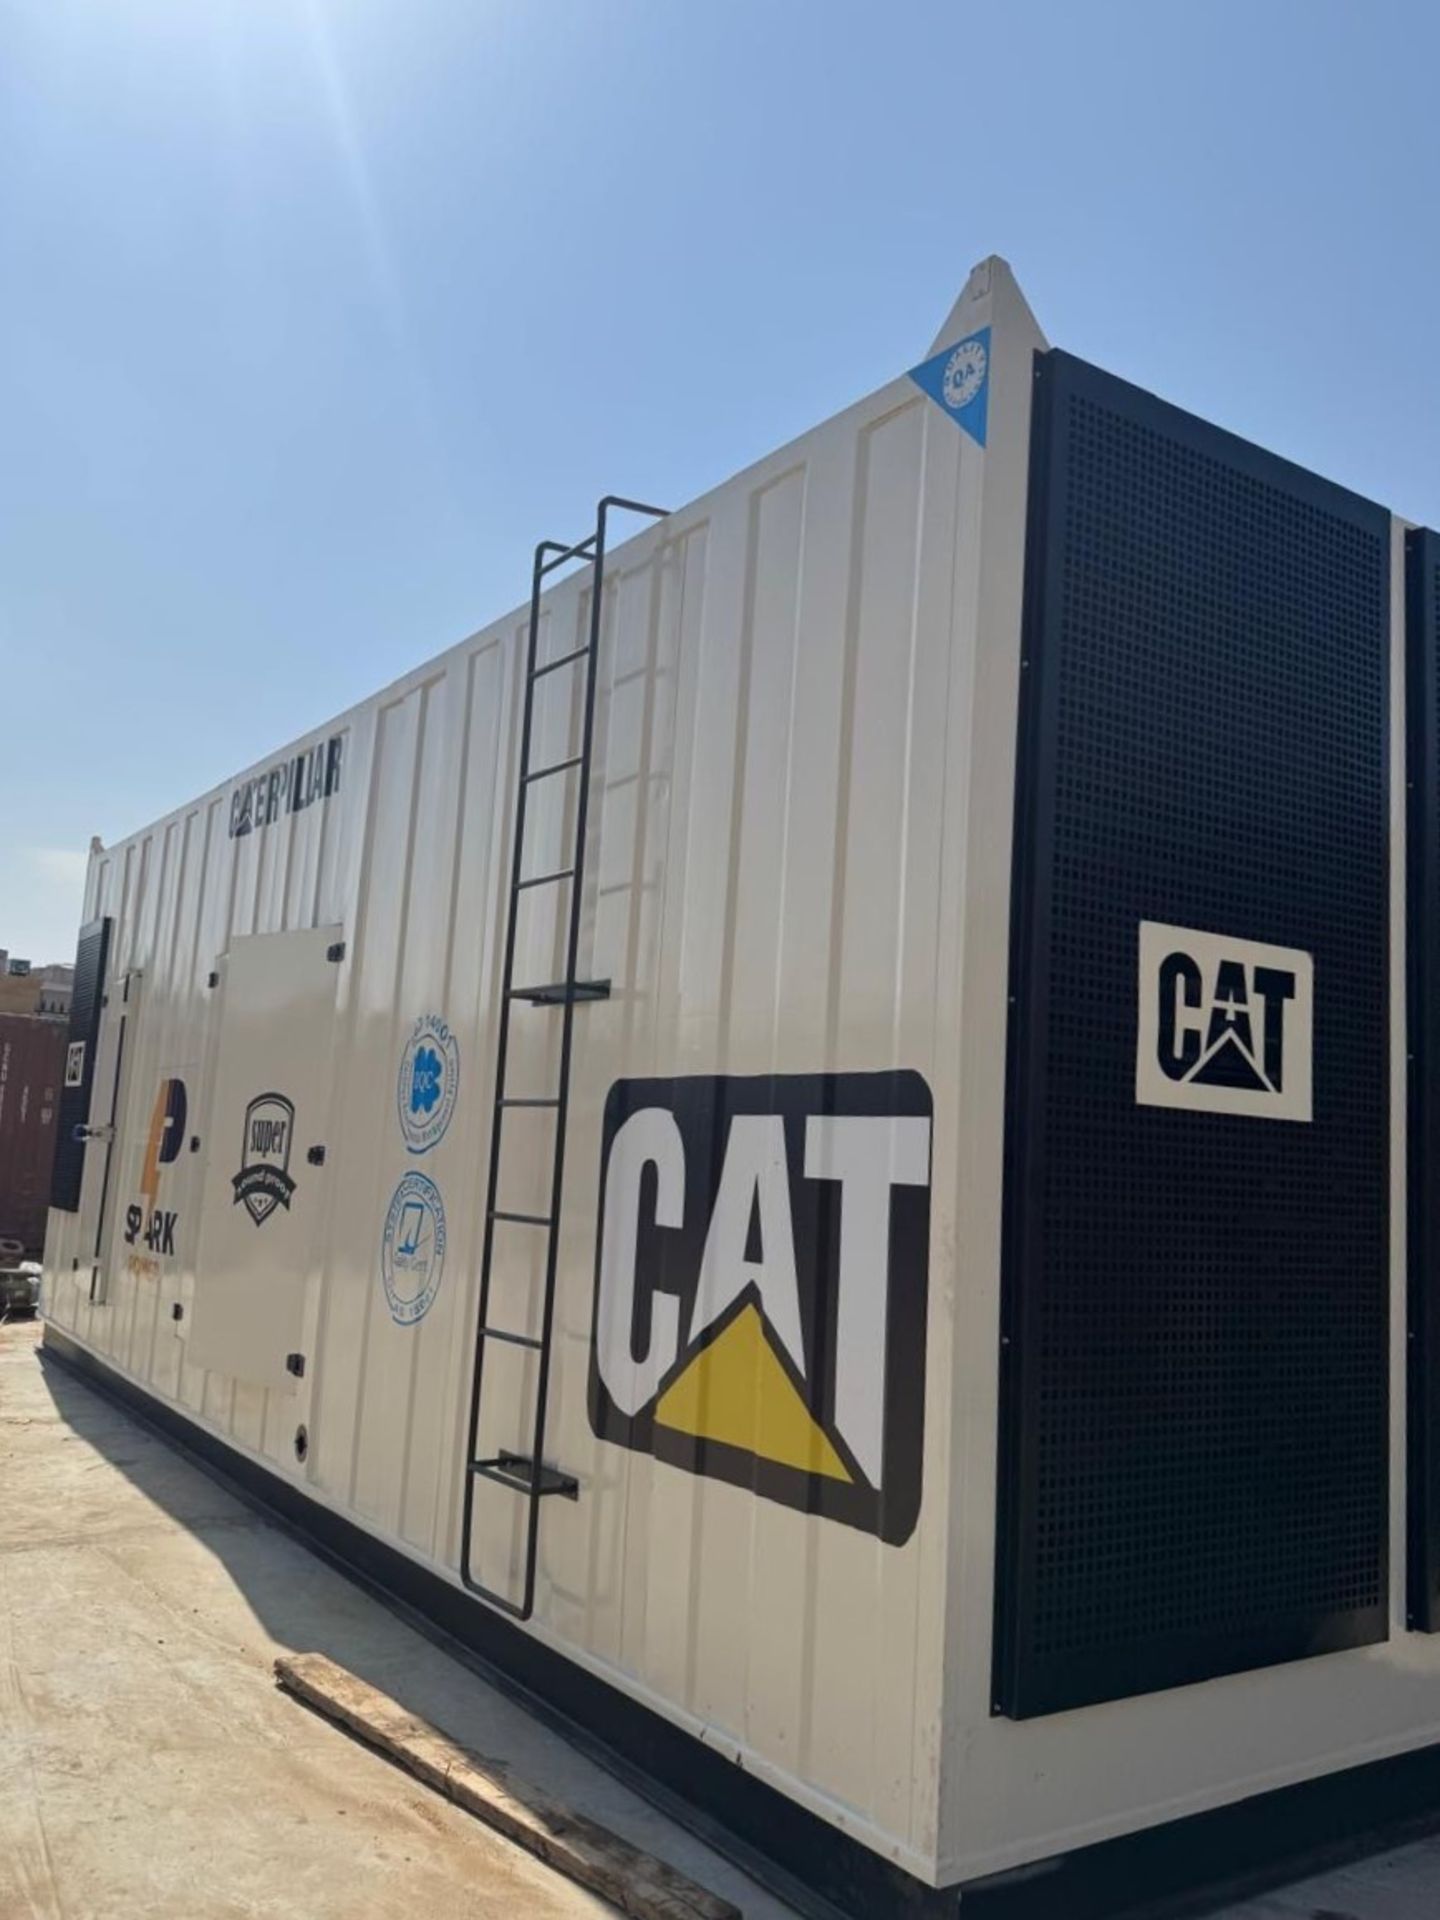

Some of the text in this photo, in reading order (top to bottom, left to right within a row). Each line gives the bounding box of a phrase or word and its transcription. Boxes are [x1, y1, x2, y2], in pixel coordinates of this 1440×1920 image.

[1156, 951, 1296, 1094] CAT
[250, 1119, 287, 1158] super
[597, 1106, 931, 1492] CAT
